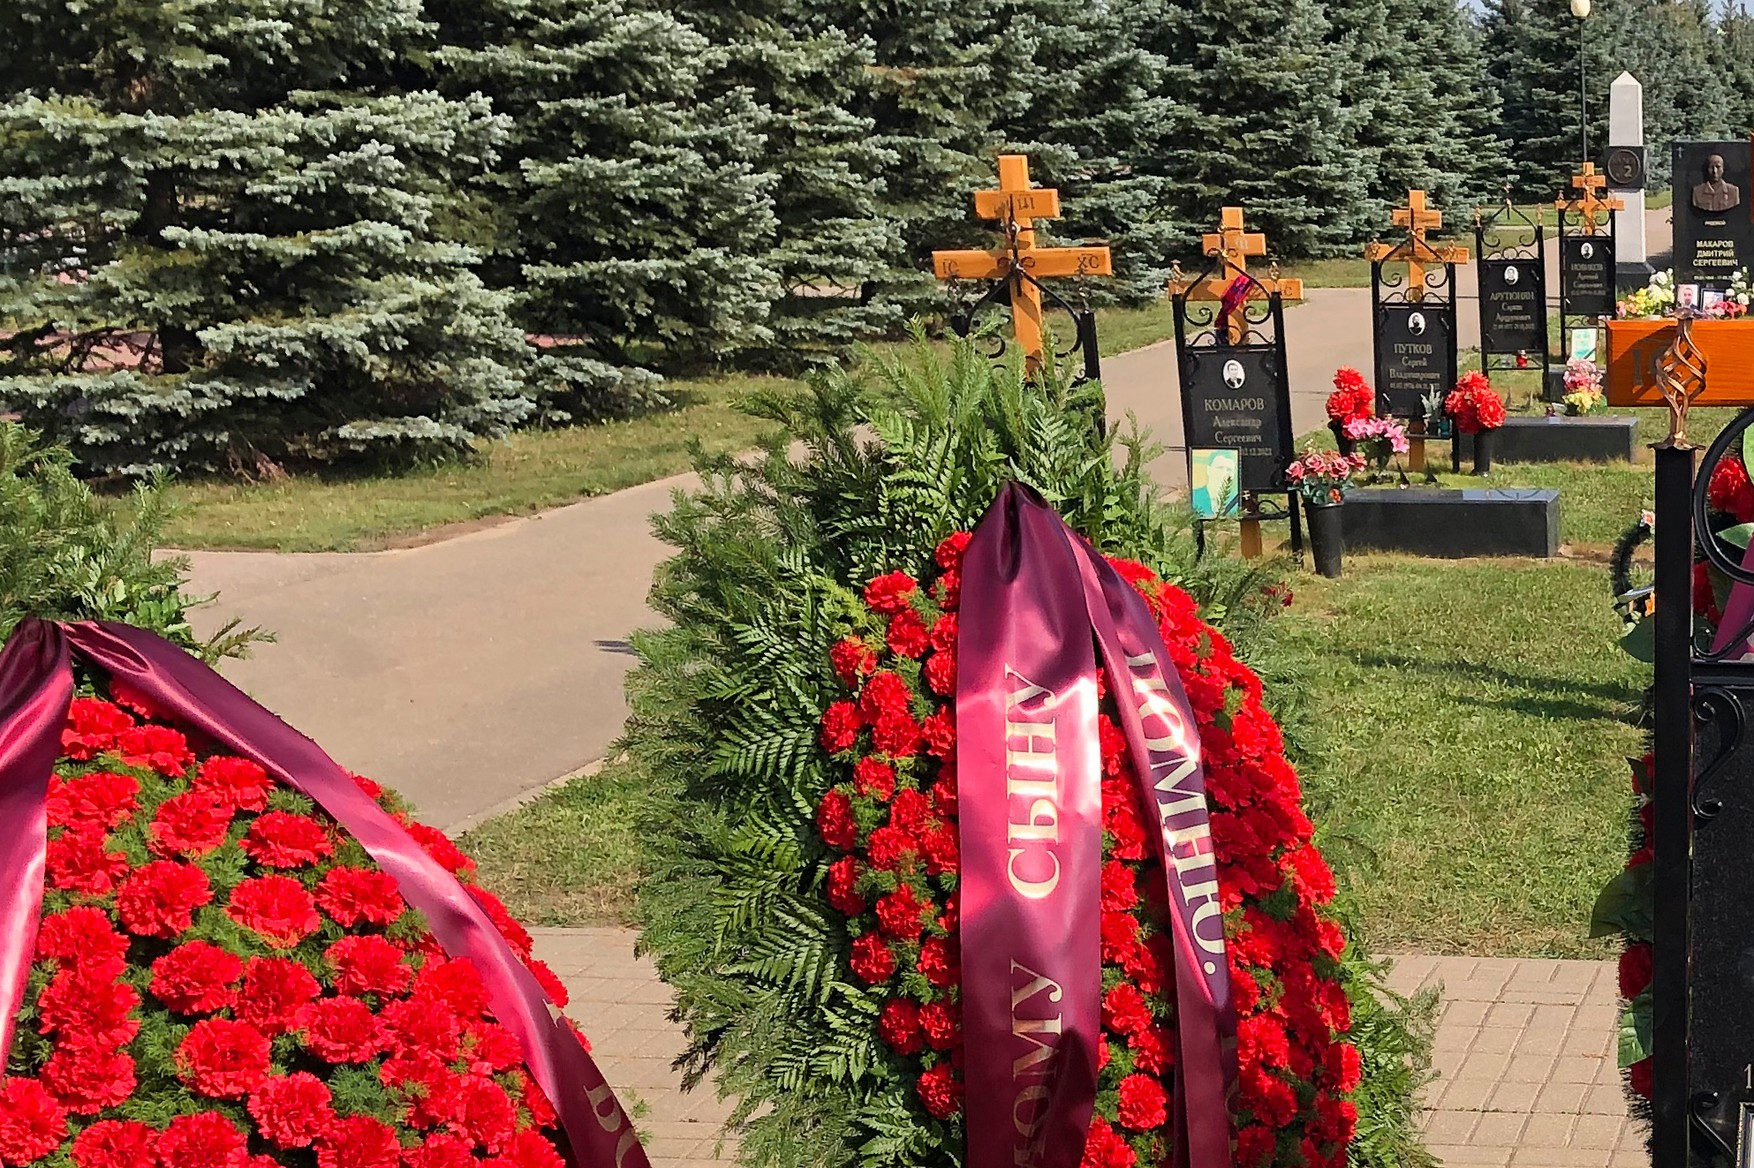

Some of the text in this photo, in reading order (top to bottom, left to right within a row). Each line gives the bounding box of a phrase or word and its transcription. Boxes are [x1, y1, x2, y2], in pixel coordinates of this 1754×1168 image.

[1696, 240, 1734, 248] МАКАРОВ
[1696, 249, 1735, 258] ДМИТРИЙ
[1692, 258, 1739, 267] СЕРГЕЕВИЧ
[1394, 343, 1433, 355] ПУТКОВ
[1204, 397, 1265, 412] КОМАРОВ
[1003, 664, 1063, 900] СЫНУ
